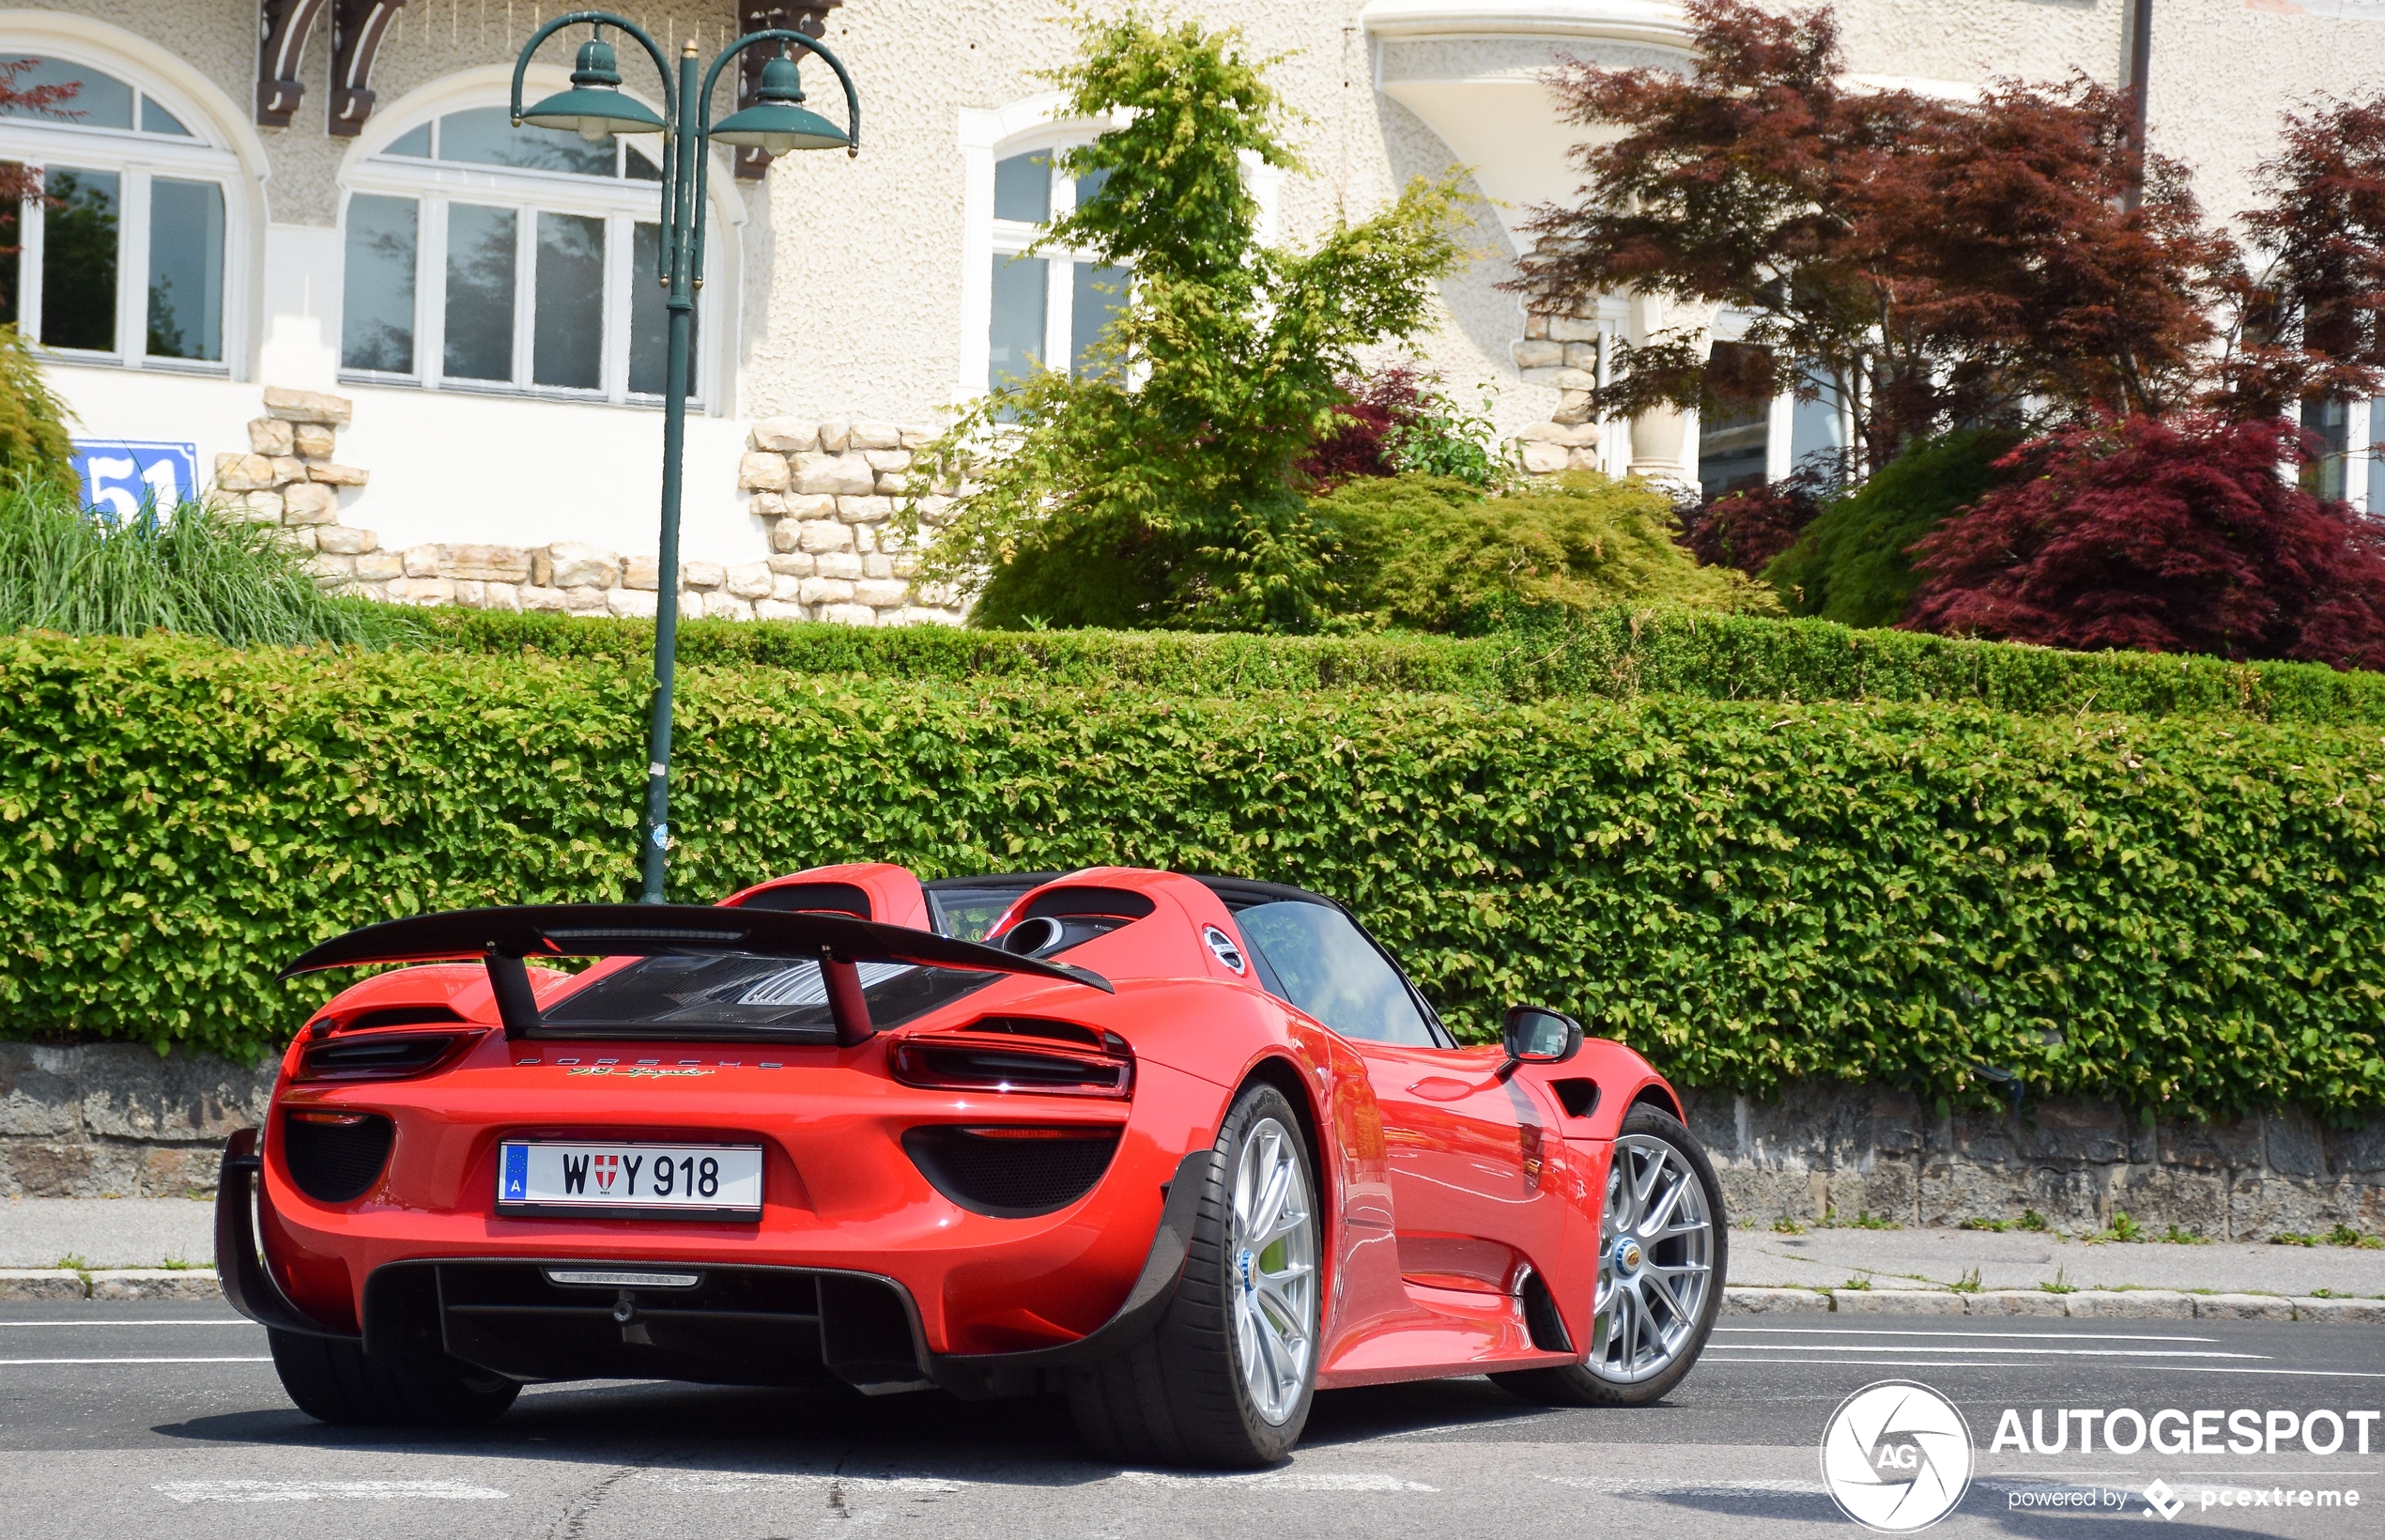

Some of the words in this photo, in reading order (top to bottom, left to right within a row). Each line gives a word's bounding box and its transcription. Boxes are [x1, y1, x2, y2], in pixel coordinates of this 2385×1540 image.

[87, 456, 177, 539] 51
[516, 1058, 783, 1070] PORSCHE
[510, 1179, 521, 1193] A
[563, 1153, 590, 1194] W
[623, 1154, 643, 1196] Y
[654, 1155, 719, 1197] 918
